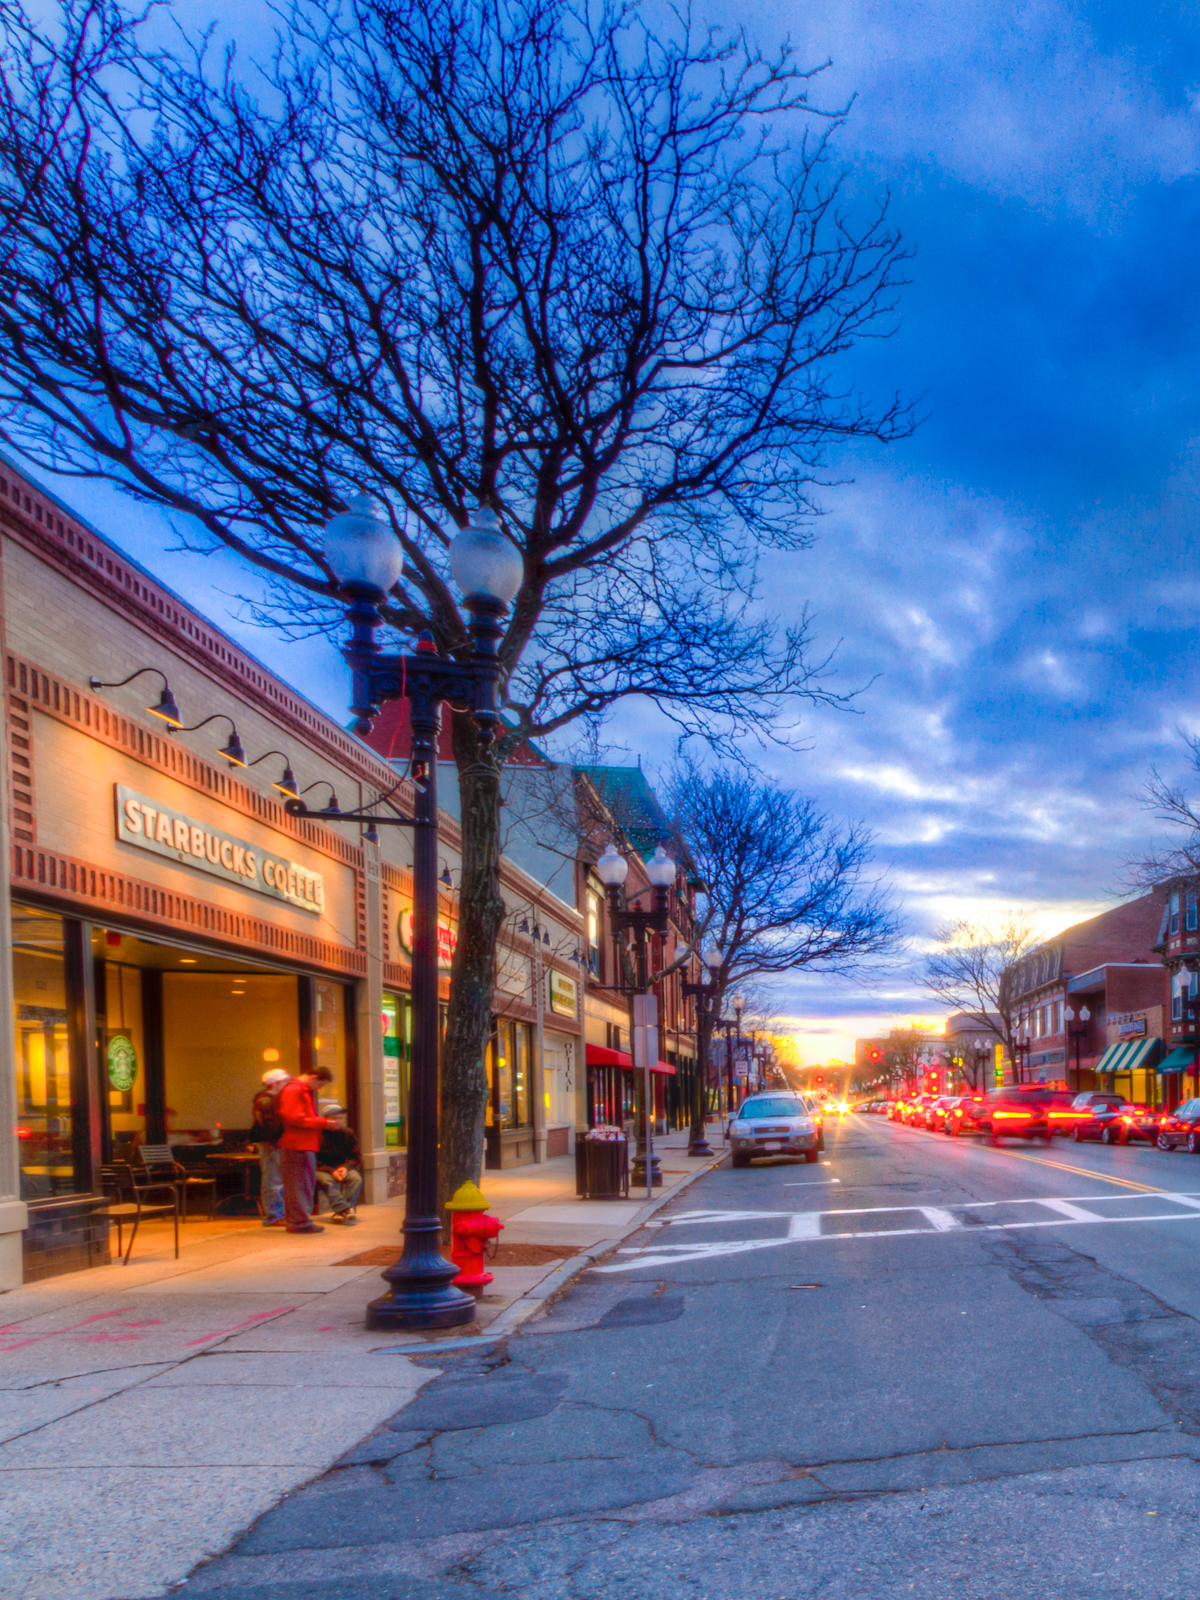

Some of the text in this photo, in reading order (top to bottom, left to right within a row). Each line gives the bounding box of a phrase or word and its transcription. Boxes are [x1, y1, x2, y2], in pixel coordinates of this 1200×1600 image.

[124, 799, 323, 905] STARBUCKS COFFEE
[564, 1042, 573, 1092] OPTICAL
